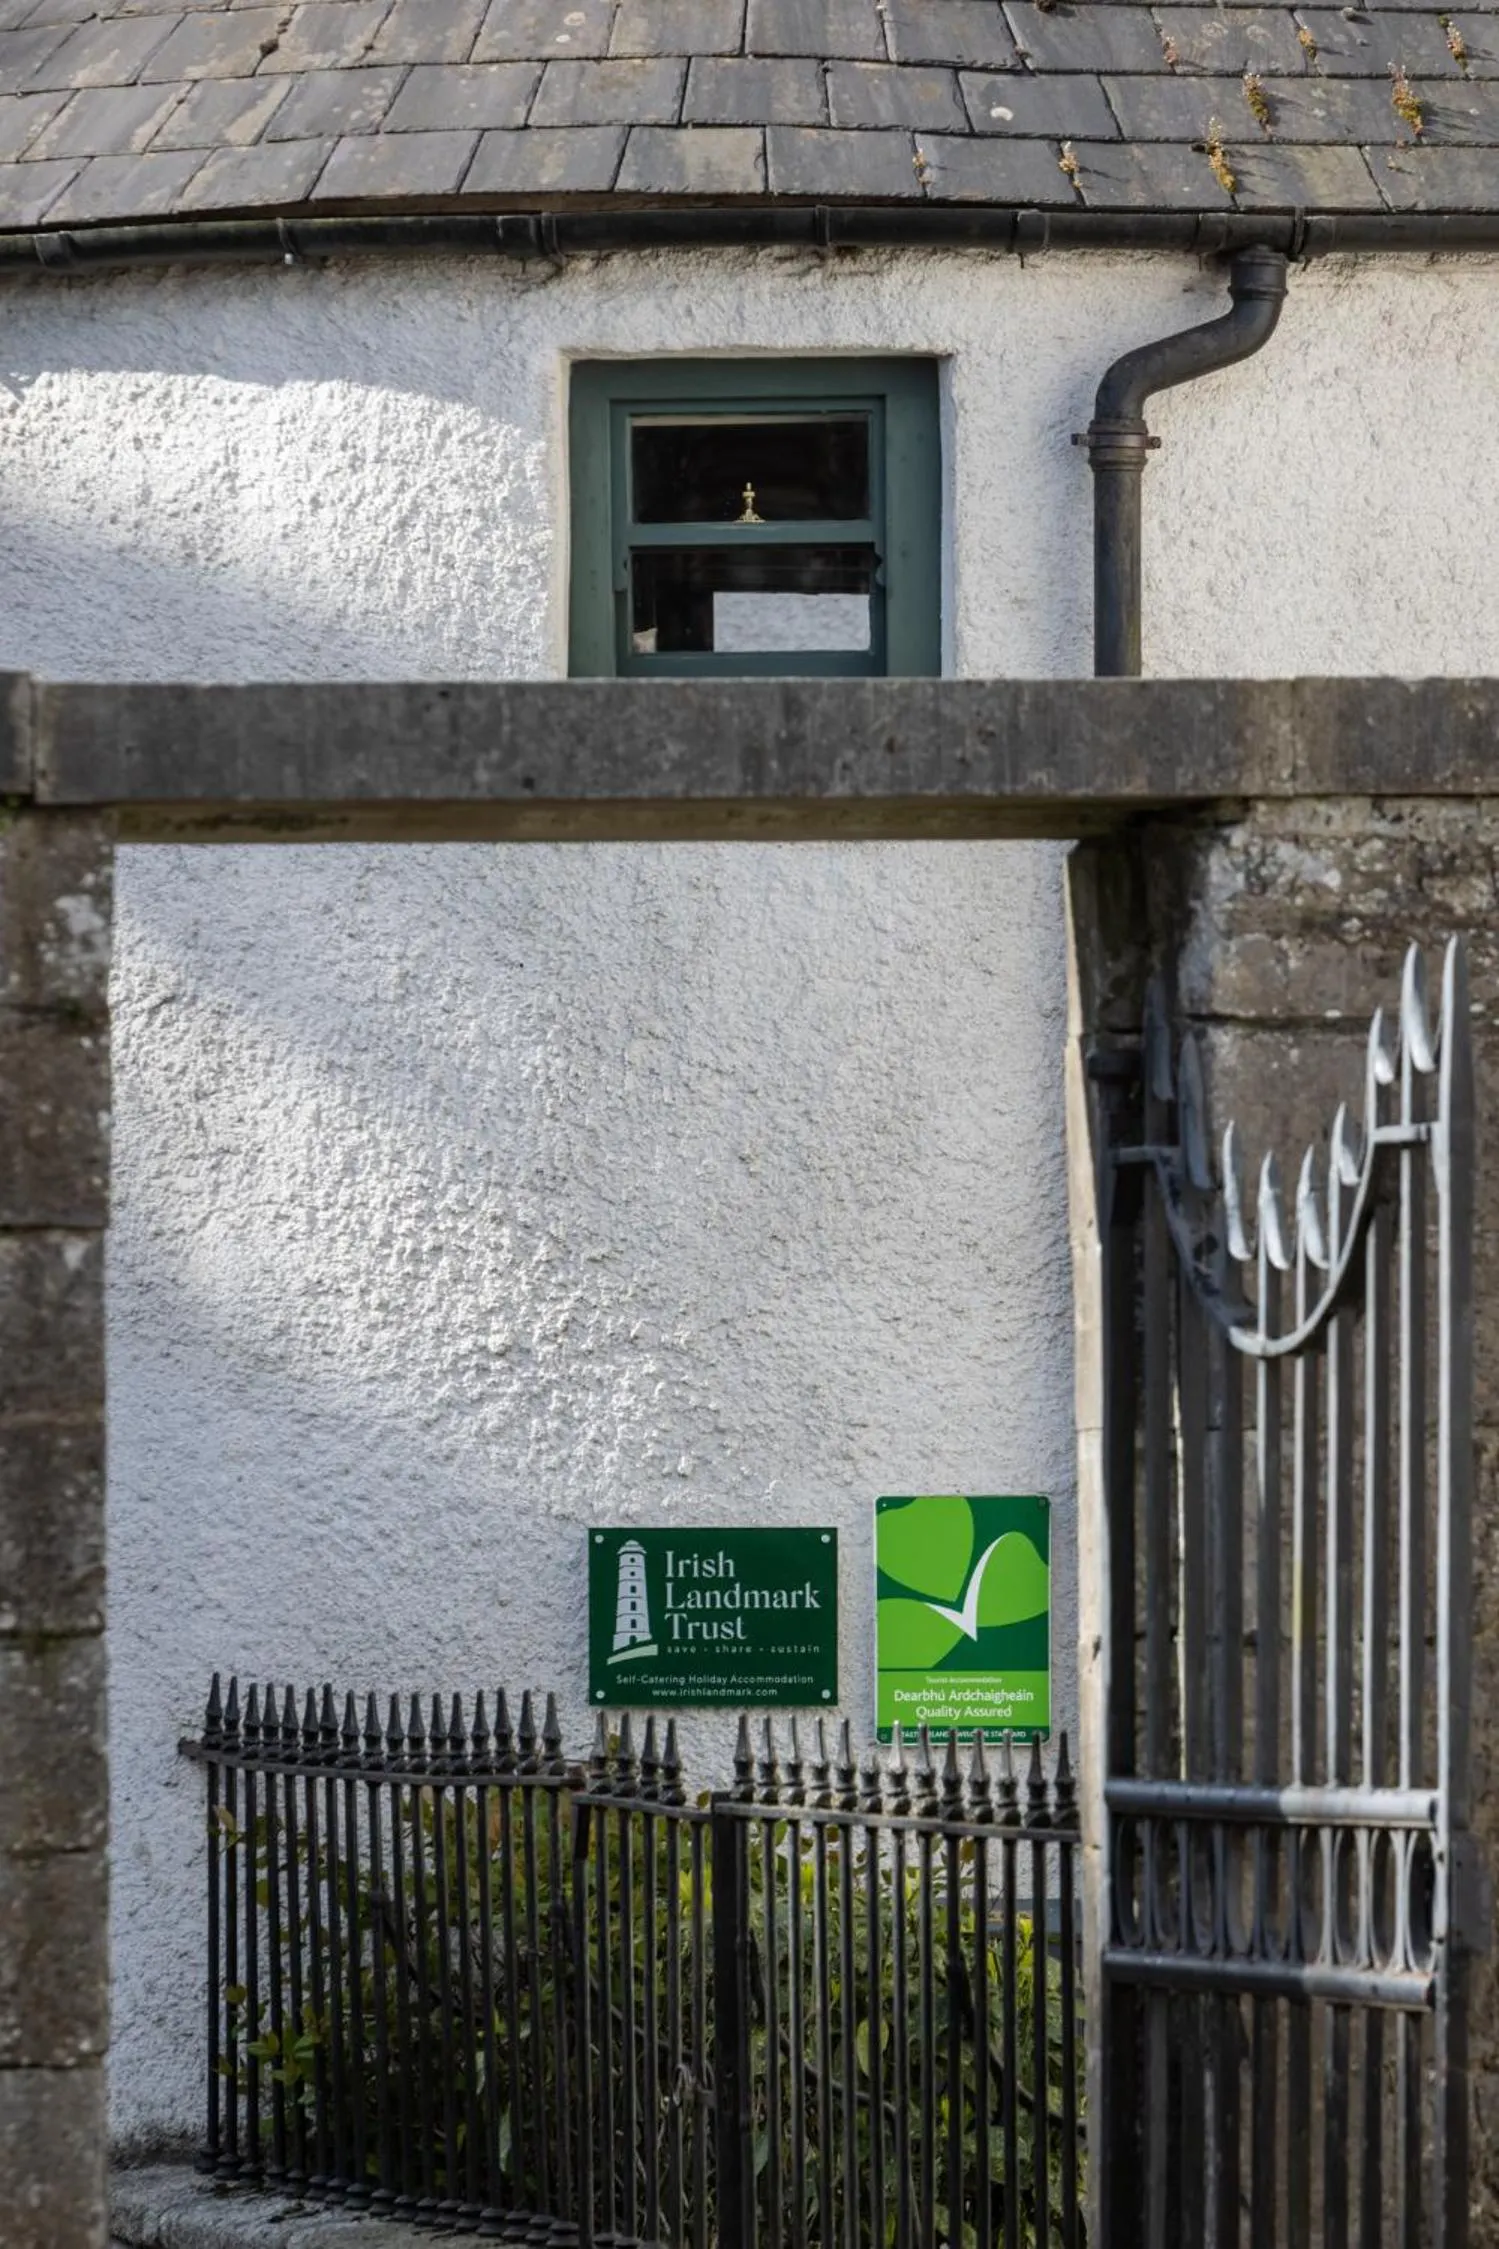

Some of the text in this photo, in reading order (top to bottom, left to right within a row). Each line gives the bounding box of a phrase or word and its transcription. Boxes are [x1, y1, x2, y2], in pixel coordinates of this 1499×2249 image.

[665, 1551, 736, 1578] Irish
[664, 1582, 822, 1609] Landmark
[664, 1613, 748, 1640] Trust
[667, 1645, 820, 1653] save share sustain
[616, 1674, 814, 1685] Self-Catering Holiday Accommodation
[652, 1687, 778, 1697] www.irishlandmark.com
[916, 1706, 1012, 1720] Quality Assured
